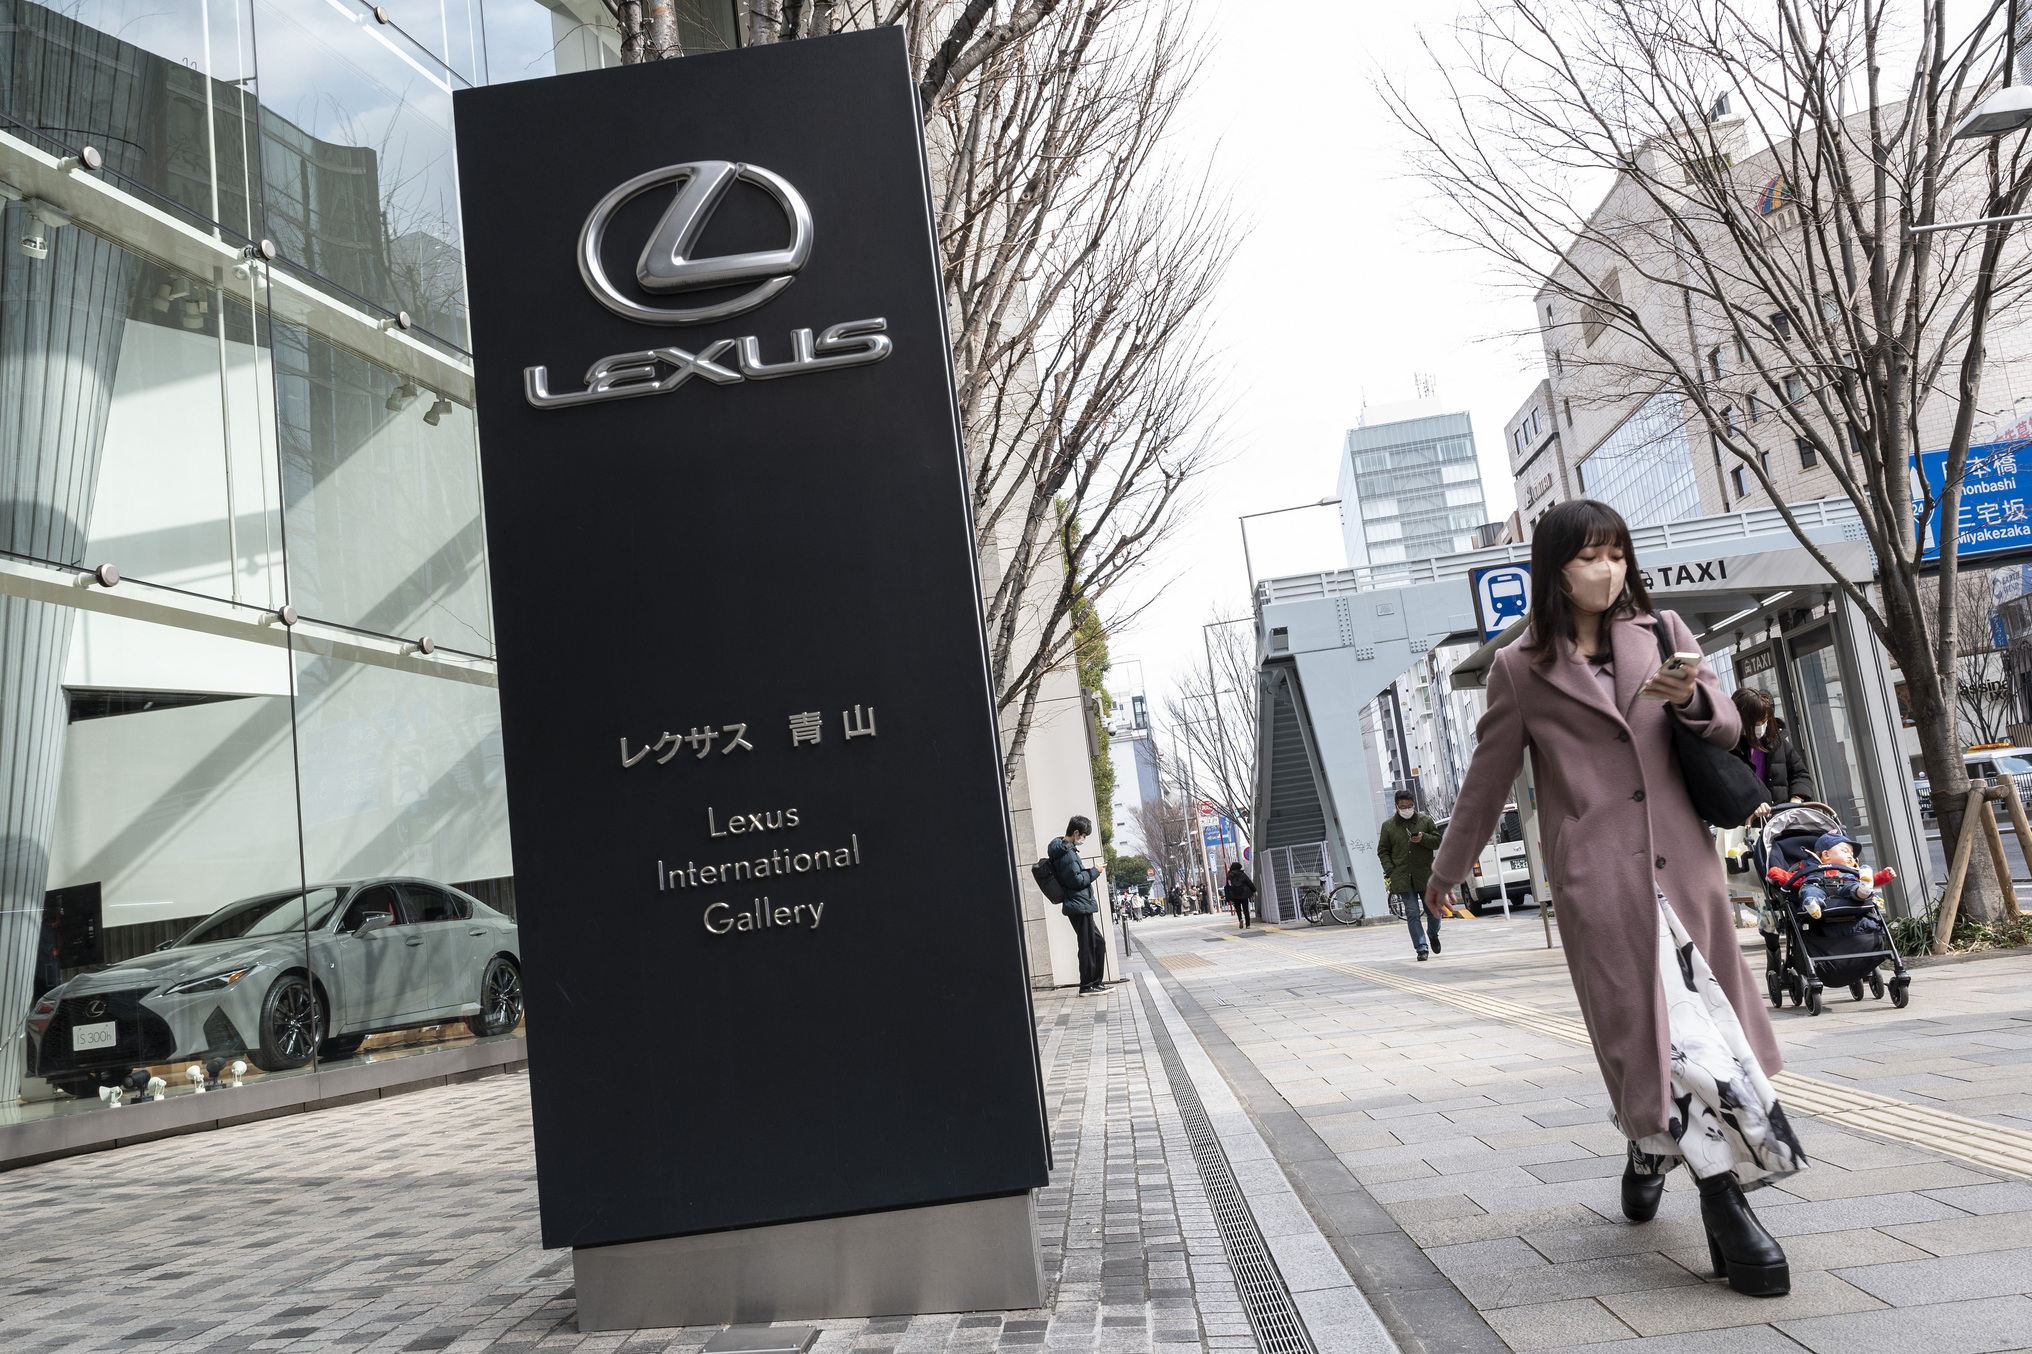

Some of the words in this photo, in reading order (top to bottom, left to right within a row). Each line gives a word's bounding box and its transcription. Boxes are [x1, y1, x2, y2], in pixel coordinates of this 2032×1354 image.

[524, 317, 893, 410] LEXUS
[1958, 498, 2028, 528] 三宅坂
[1658, 560, 1727, 586] TAXI
[1751, 652, 1772, 672] TAXI
[619, 722, 753, 768] レクサス
[788, 704, 877, 747] 青山
[707, 806, 800, 838] Lexus
[657, 833, 860, 891] International
[703, 896, 824, 935] Gallery
[76, 1033, 86, 1045] IS
[88, 1031, 112, 1044] 300h
